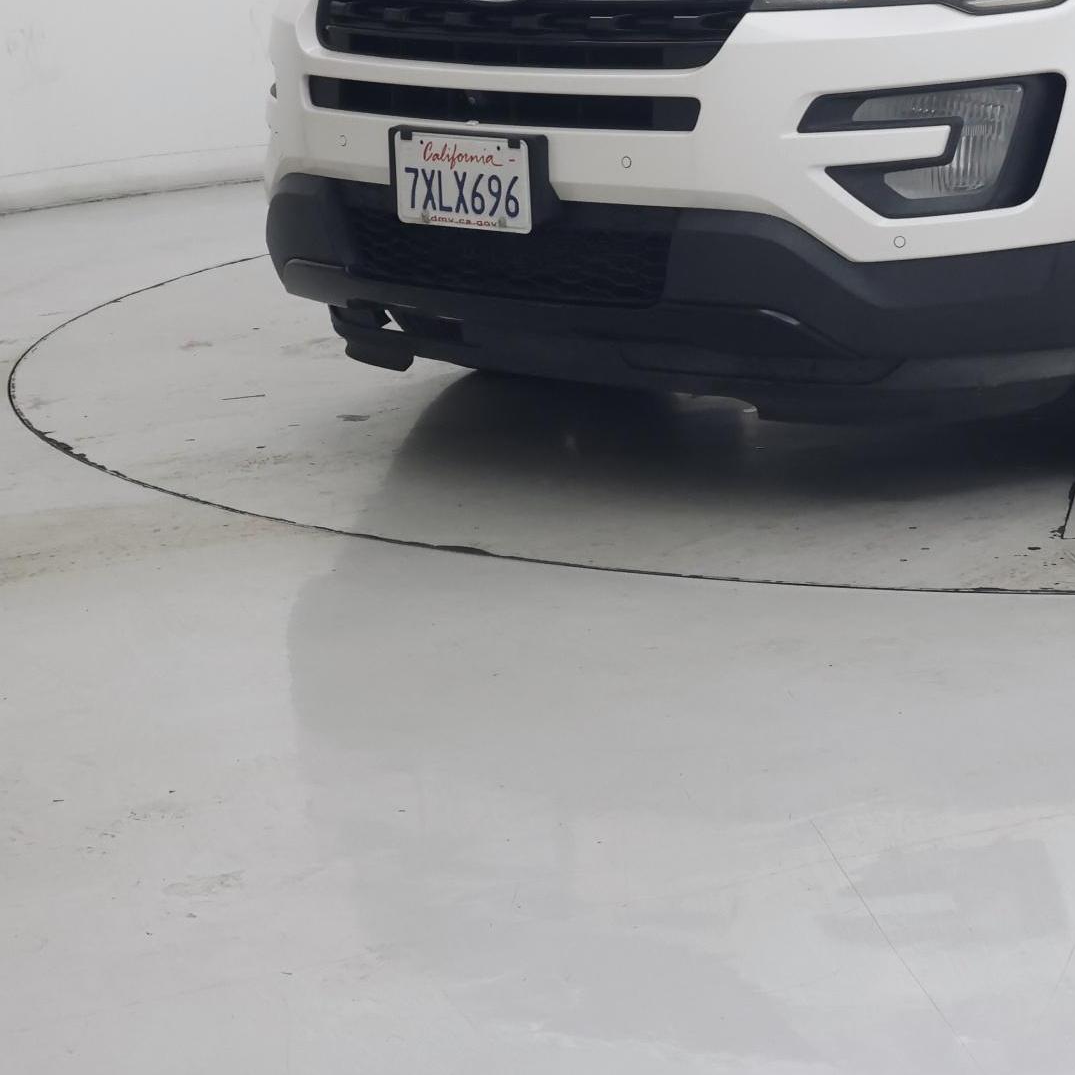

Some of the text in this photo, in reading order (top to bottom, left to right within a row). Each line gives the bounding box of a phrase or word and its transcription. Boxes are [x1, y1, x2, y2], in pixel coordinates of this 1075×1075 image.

[423, 140, 504, 170] California
[404, 166, 520, 219] 7XLX696
[430, 216, 497, 228] dmv.ca.gov
